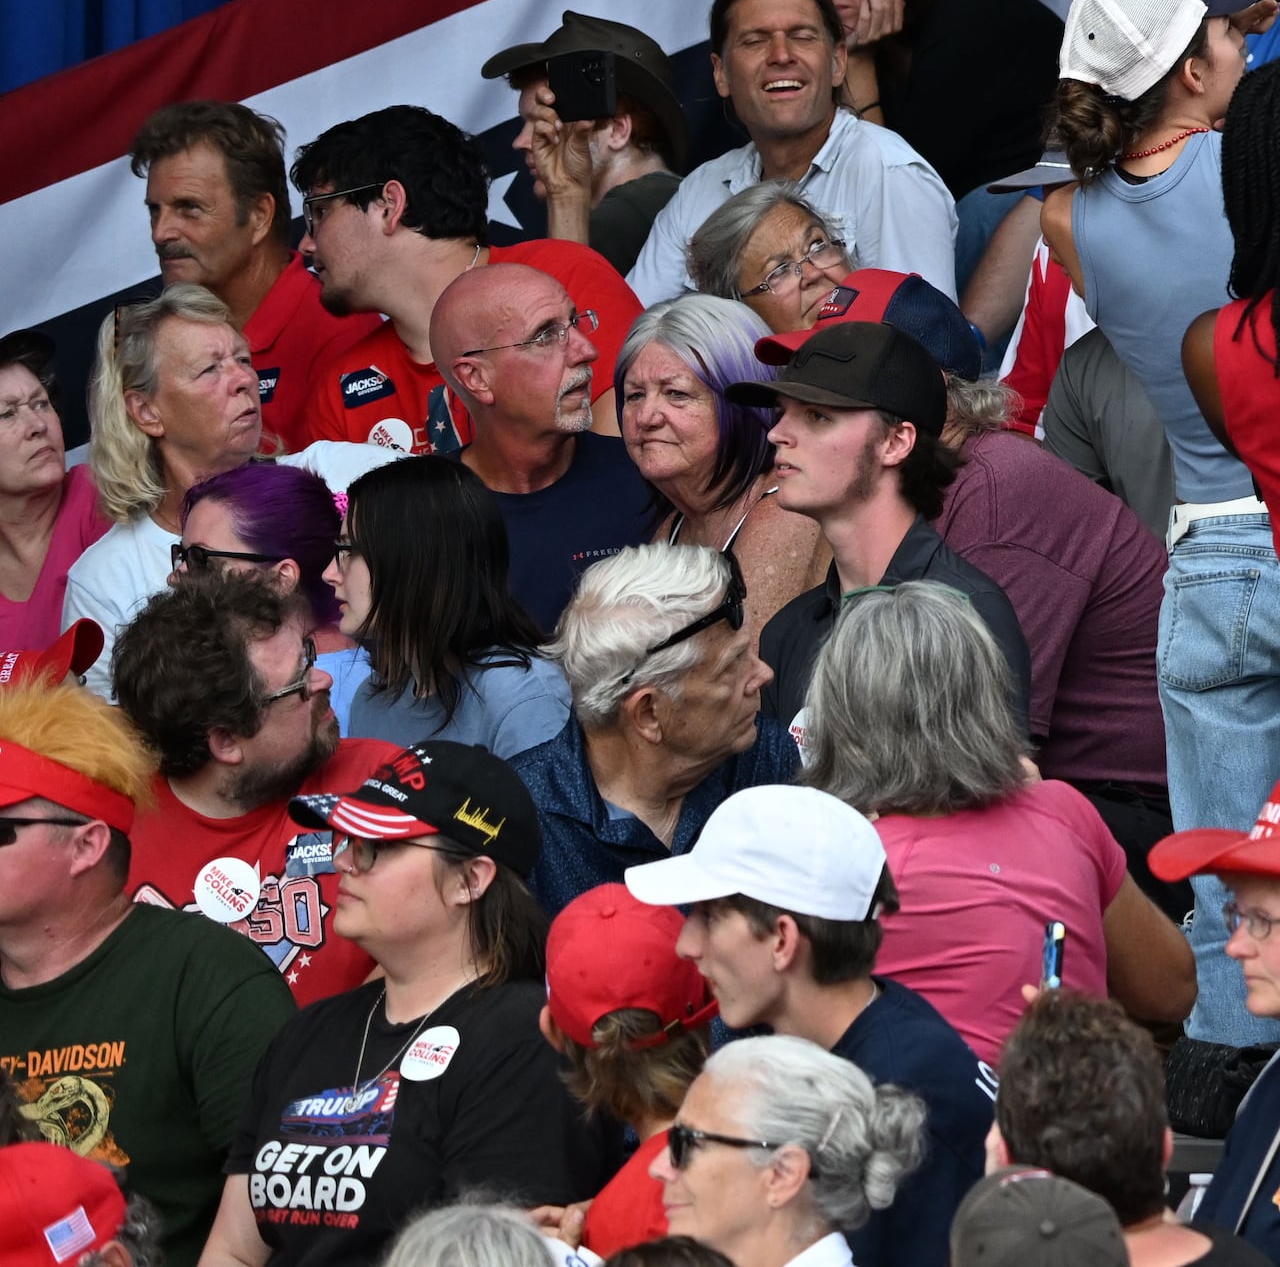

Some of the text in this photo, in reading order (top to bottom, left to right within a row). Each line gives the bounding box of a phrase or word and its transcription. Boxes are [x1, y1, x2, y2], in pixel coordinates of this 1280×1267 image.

[382, 784, 409, 803] GREAT
[210, 865, 234, 888] MIKE
[203, 873, 247, 914] COLLINS
[415, 1040, 434, 1052] MIKE
[408, 1048, 448, 1066] COLLINS
[255, 1140, 388, 1179] GET ON
[251, 1173, 366, 1212] BOARD
[290, 1210, 321, 1225] RUN
[323, 1212, 360, 1230] OVER
